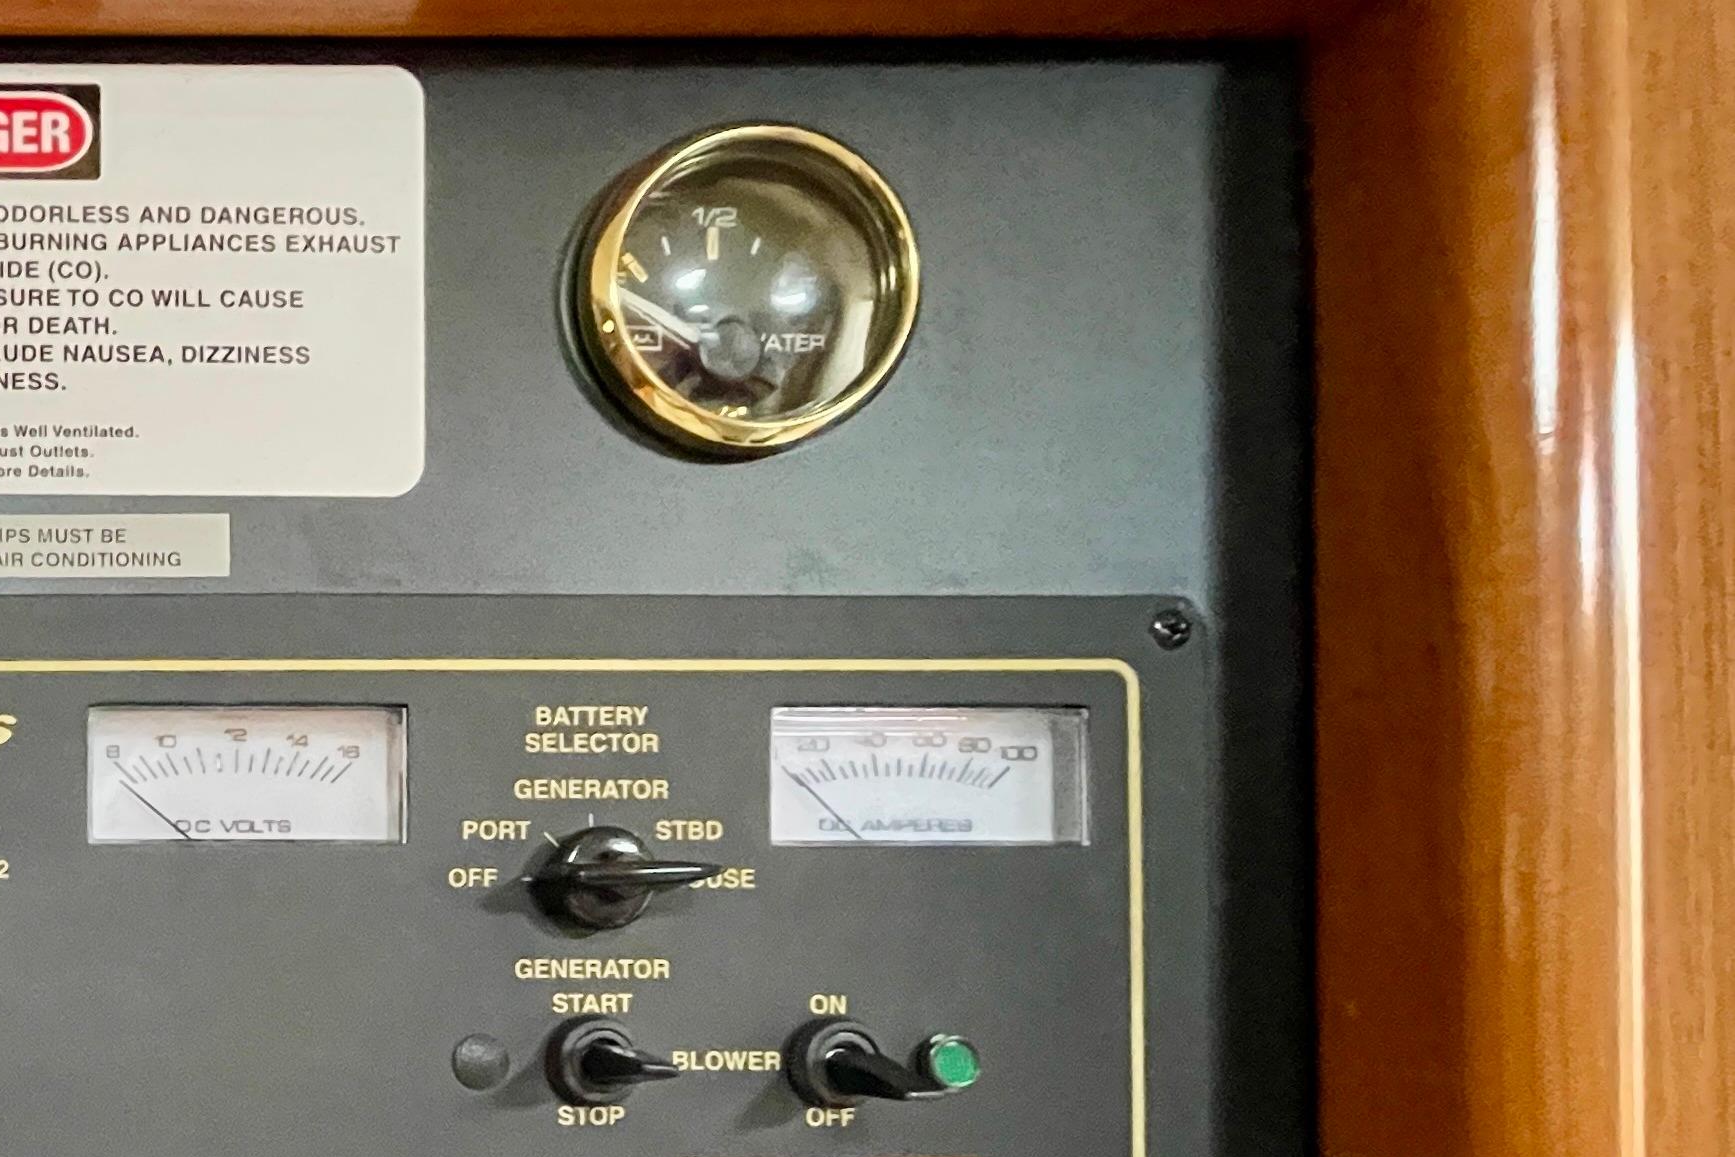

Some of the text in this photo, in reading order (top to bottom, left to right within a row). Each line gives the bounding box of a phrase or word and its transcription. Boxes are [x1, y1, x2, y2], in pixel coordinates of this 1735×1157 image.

[139, 206, 191, 224] AND
[200, 206, 365, 226] DANGEROUS.
[117, 233, 276, 253] APPLIANCES
[285, 234, 401, 254] EXHAUST
[48, 260, 109, 284] (CO).
[67, 288, 99, 307] TO
[108, 288, 144, 308] CO
[151, 289, 211, 308] WILL
[219, 289, 304, 309] CAUSE
[28, 316, 117, 335] DEATH.
[63, 344, 173, 366] NAUSEA,
[181, 345, 310, 365] DIZZINESS
[13, 424, 48, 438] Well
[52, 425, 139, 438] Ventilated.
[29, 444, 94, 458] Outlets.
[28, 464, 90, 478] Details.
[37, 528, 94, 544] MUST
[100, 528, 126, 544] BE
[30, 551, 182, 568] CONDITIONING
[535, 706, 648, 727] BATTERY
[525, 732, 659, 754] SELECTOR
[513, 779, 669, 800] GENERATOR
[462, 820, 532, 841] PORT
[655, 820, 723, 841] STBD
[448, 867, 498, 888] OFF
[514, 958, 670, 979] GENERATOR
[552, 992, 633, 1014] START
[809, 994, 847, 1015] ON
[672, 1050, 781, 1071] BLOWER
[557, 1105, 626, 1126] STOP
[805, 1107, 856, 1128] OFF
